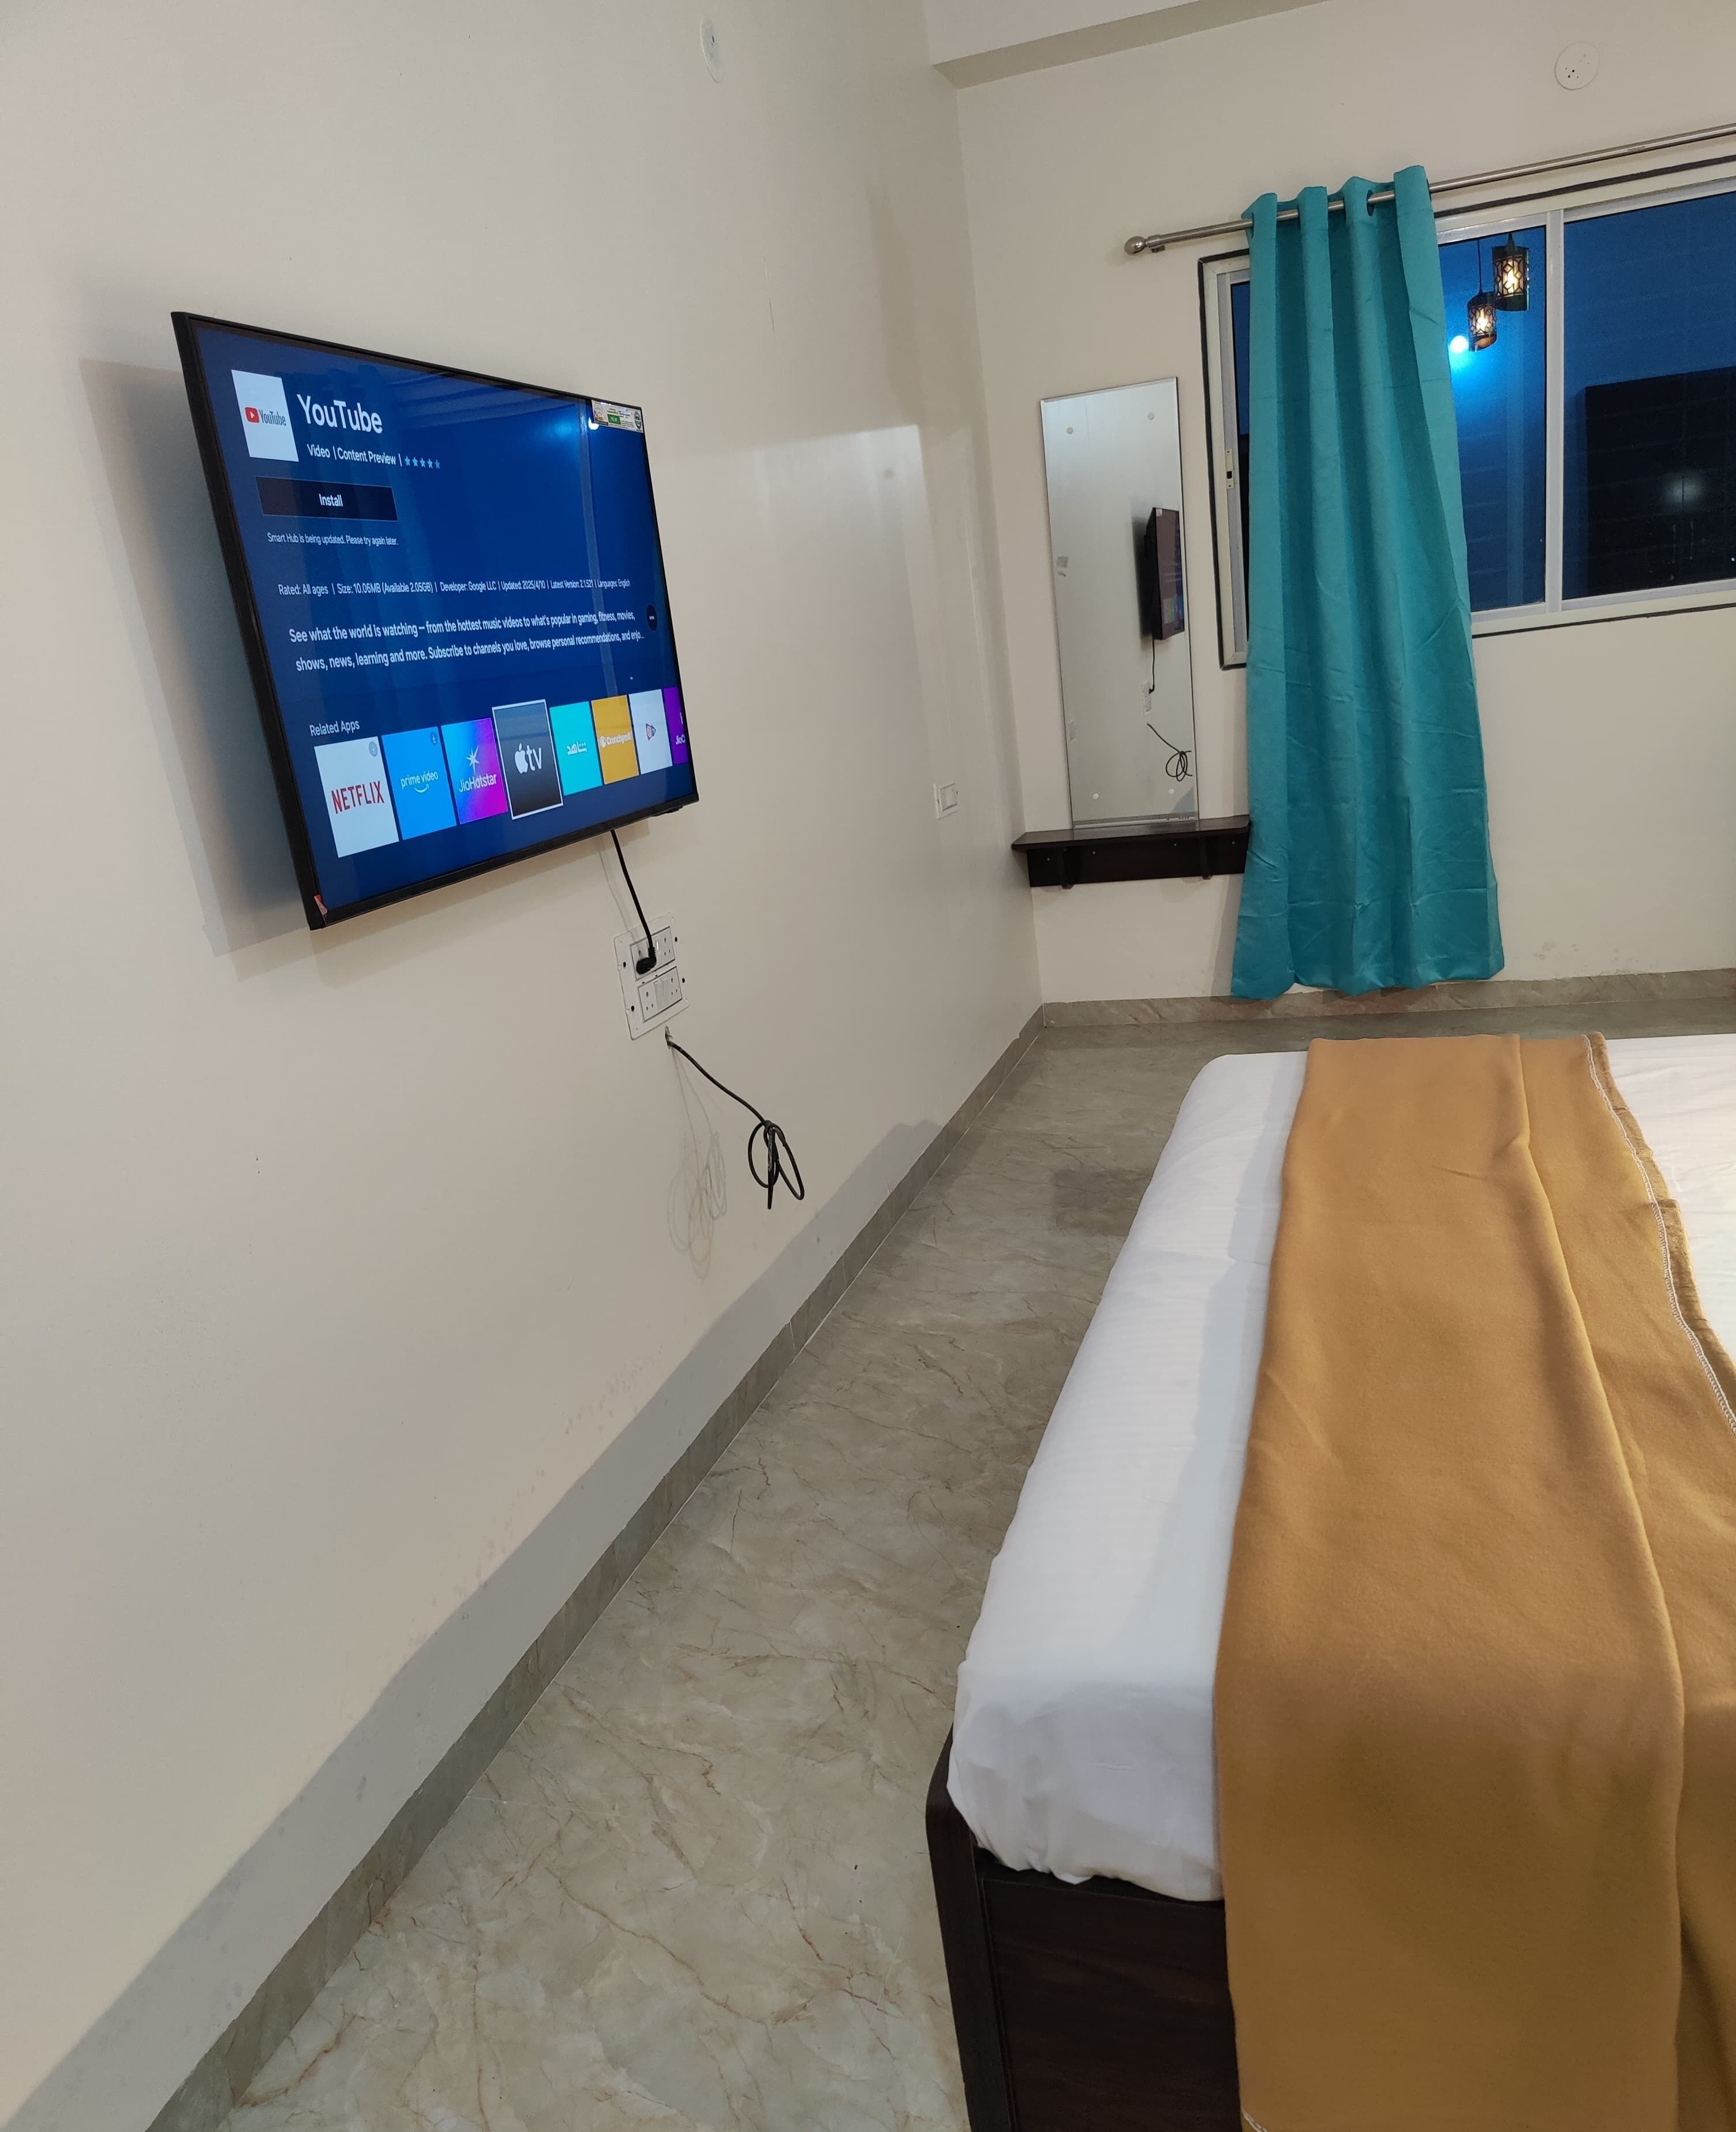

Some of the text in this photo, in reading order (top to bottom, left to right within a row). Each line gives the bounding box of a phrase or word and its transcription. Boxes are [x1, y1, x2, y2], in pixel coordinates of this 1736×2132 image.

[260, 409, 287, 426] YouTube
[296, 394, 383, 434] YouTube
[306, 444, 331, 458] Video
[337, 447, 368, 462] Content
[368, 451, 396, 466] Preview
[319, 493, 343, 507] Install
[267, 532, 286, 543] Smart
[286, 533, 299, 543] Hub
[299, 534, 305, 543] is
[305, 534, 321, 545] being
[321, 534, 346, 545] updated.
[346, 534, 363, 544] Please
[372, 536, 386, 547] again
[385, 536, 399, 545] later.
[278, 584, 302, 595] Rated:
[302, 584, 312, 594] All
[312, 585, 328, 597] ages
[336, 583, 353, 594] Size:
[353, 582, 381, 594] 10.06MB
[381, 582, 409, 594] (Available
[410, 581, 433, 593] 2.05GB)
[440, 581, 468, 593] Developer:
[468, 581, 486, 593] Google
[486, 580, 497, 590] LLC
[501, 581, 522, 592] Updated:
[522, 579, 545, 590] 2025/4/10
[550, 579, 564, 589] Latest
[618, 578, 631, 589] English
[289, 628, 308, 642] See
[308, 627, 332, 641] what
[332, 626, 347, 639] the
[349, 624, 373, 638] world
[373, 623, 381, 637] is
[382, 622, 418, 637] watching
[426, 620, 444, 633] from
[444, 619, 457, 632] the
[457, 619, 482, 631] hottest
[482, 617, 502, 630] music
[502, 616, 523, 629] videos
[523, 616, 530, 627] to
[531, 615, 550, 626] what's
[550, 613, 571, 628] popular
[571, 613, 577, 624] in
[578, 612, 598, 626] gaming,
[598, 611, 617, 622] fitness,
[616, 610, 635, 621] movies,
[295, 657, 328, 672] shows,
[329, 656, 355, 668] news,
[355, 651, 390, 667] learning
[390, 648, 405, 663] and
[405, 650, 428, 661] more.
[428, 644, 463, 659] Subscribe
[464, 645, 472, 656] to
[473, 641, 502, 655] channels
[502, 643, 514, 655] you
[514, 639, 530, 651] love,
[529, 638, 551, 650] browse
[551, 634, 575, 650] personal
[575, 631, 622, 645] recommendations,
[622, 630, 630, 641] and
[309, 720, 360, 736] Related Apps
[526, 745, 542, 771] tv
[401, 770, 439, 789] prime video
[458, 773, 497, 792] JioHotstar
[331, 780, 385, 814] NETFLIX
